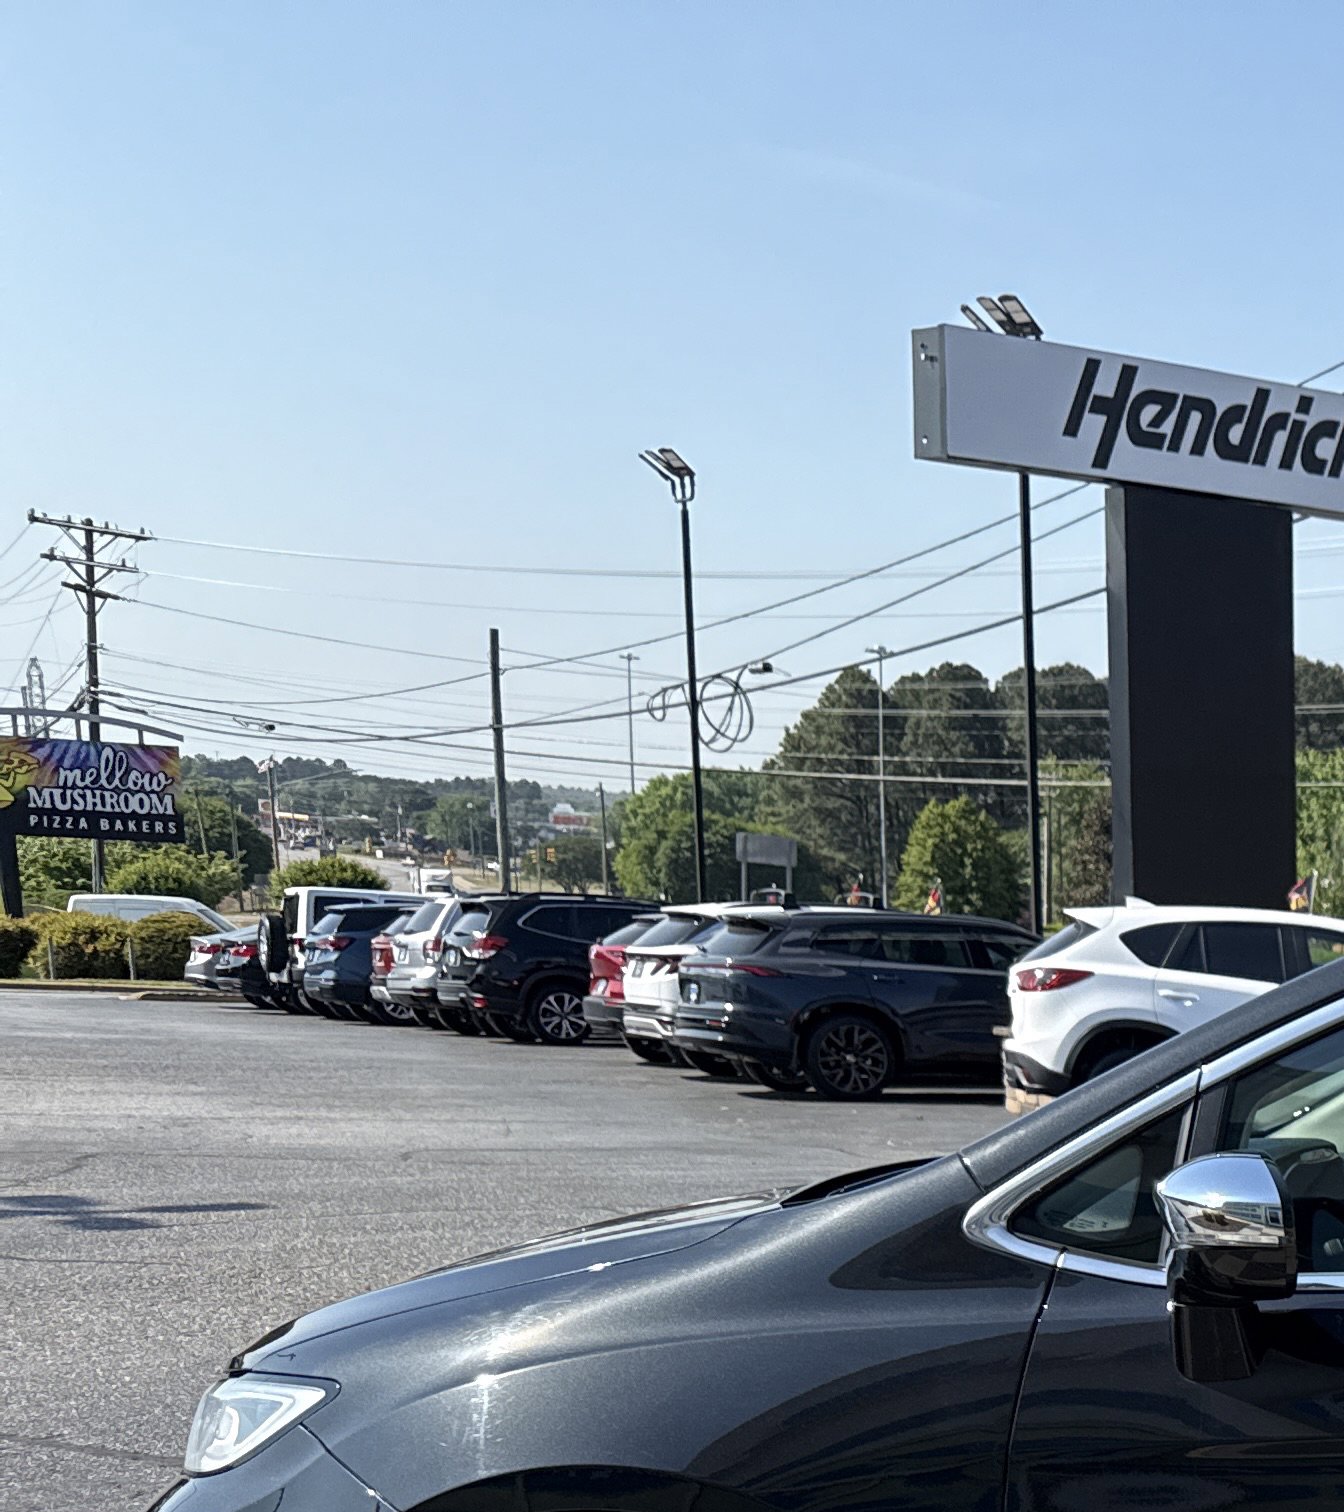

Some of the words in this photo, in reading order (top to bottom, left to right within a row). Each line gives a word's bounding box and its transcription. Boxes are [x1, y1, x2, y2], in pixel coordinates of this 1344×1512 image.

[58, 746, 173, 792] mellow
[27, 787, 175, 816] MUSHROOM
[29, 815, 89, 831] PIZZA
[100, 818, 177, 835] BAKERS
